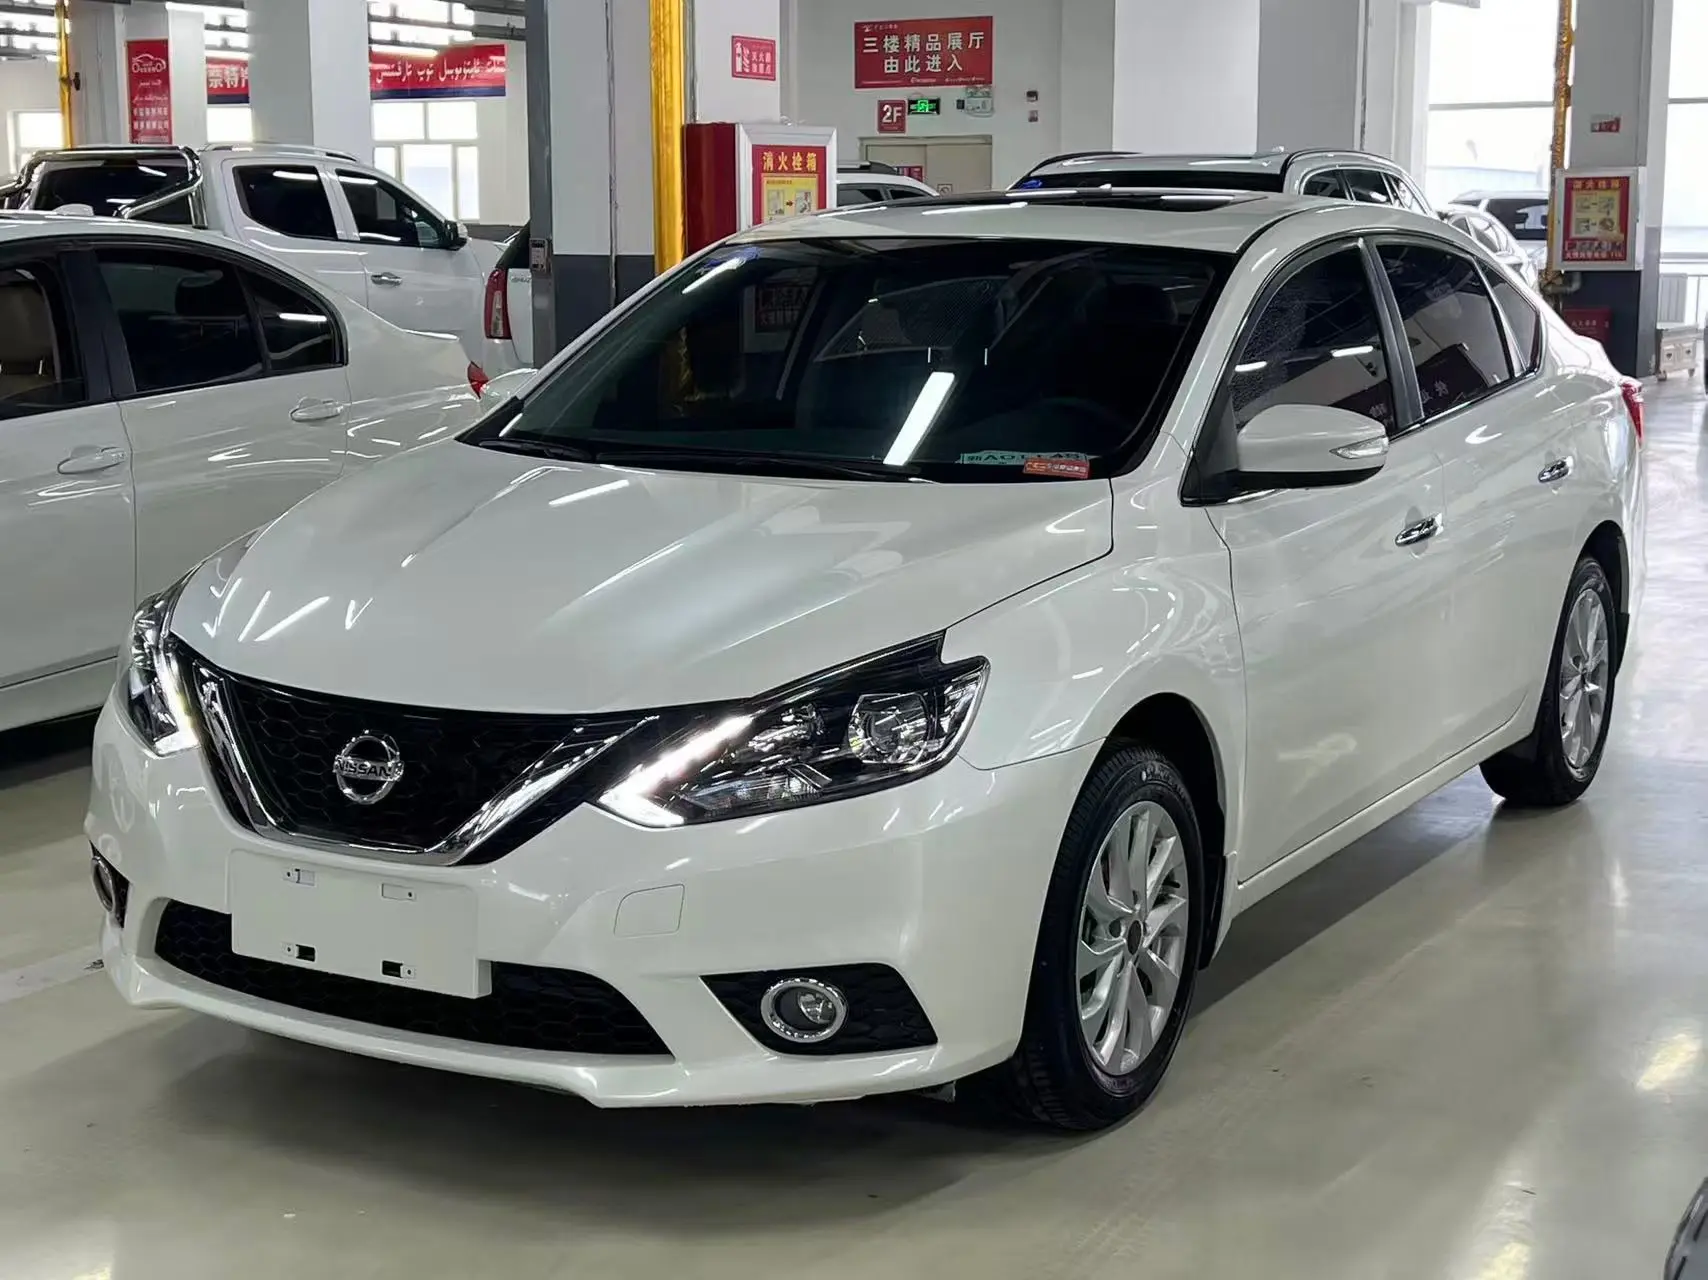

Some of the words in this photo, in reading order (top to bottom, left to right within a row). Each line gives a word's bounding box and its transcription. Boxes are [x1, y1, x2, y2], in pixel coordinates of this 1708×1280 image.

[863, 32, 984, 53] 三楼精品展厅
[884, 54, 963, 73] 由此进入
[882, 104, 902, 123] 2F
[763, 151, 817, 172] 消火栓箱
[336, 758, 393, 778] NISSAN
